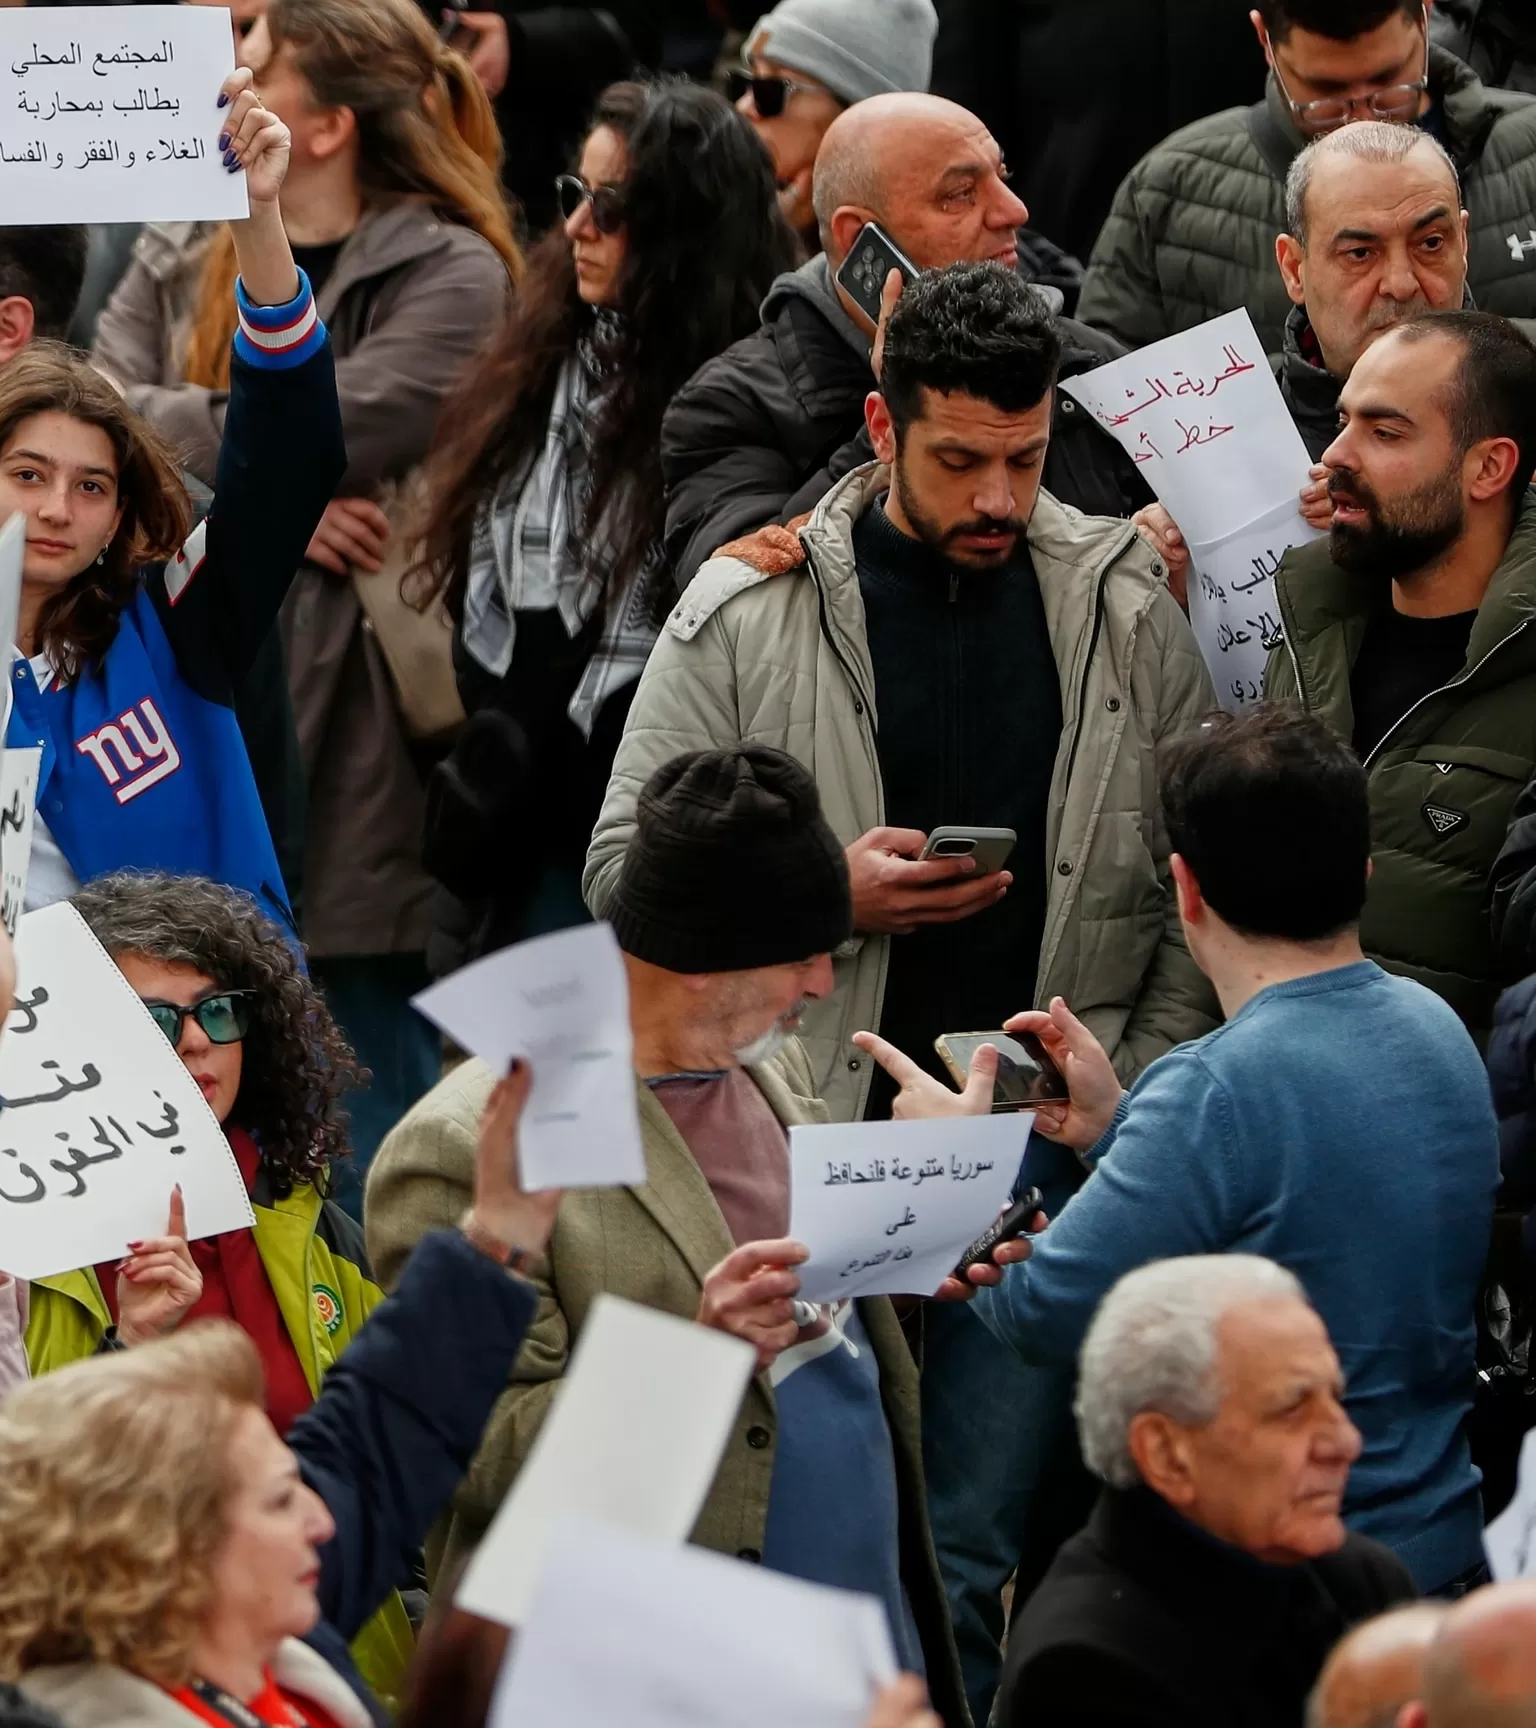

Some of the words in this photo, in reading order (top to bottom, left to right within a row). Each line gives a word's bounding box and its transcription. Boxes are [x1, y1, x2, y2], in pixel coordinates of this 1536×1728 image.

[11, 42, 82, 78] المحلي
[92, 40, 175, 77] المجتمع
[17, 90, 104, 121] بمحاربة
[112, 87, 181, 118] يطالب
[145, 137, 206, 162] الغلاء
[1174, 415, 1235, 455] خط
[136, 1090, 187, 1155] في
[824, 1159, 887, 1187] فلنحافظ
[891, 1157, 946, 1186] متنوعة
[950, 1154, 994, 1181] سوريا
[885, 1205, 917, 1236] على
